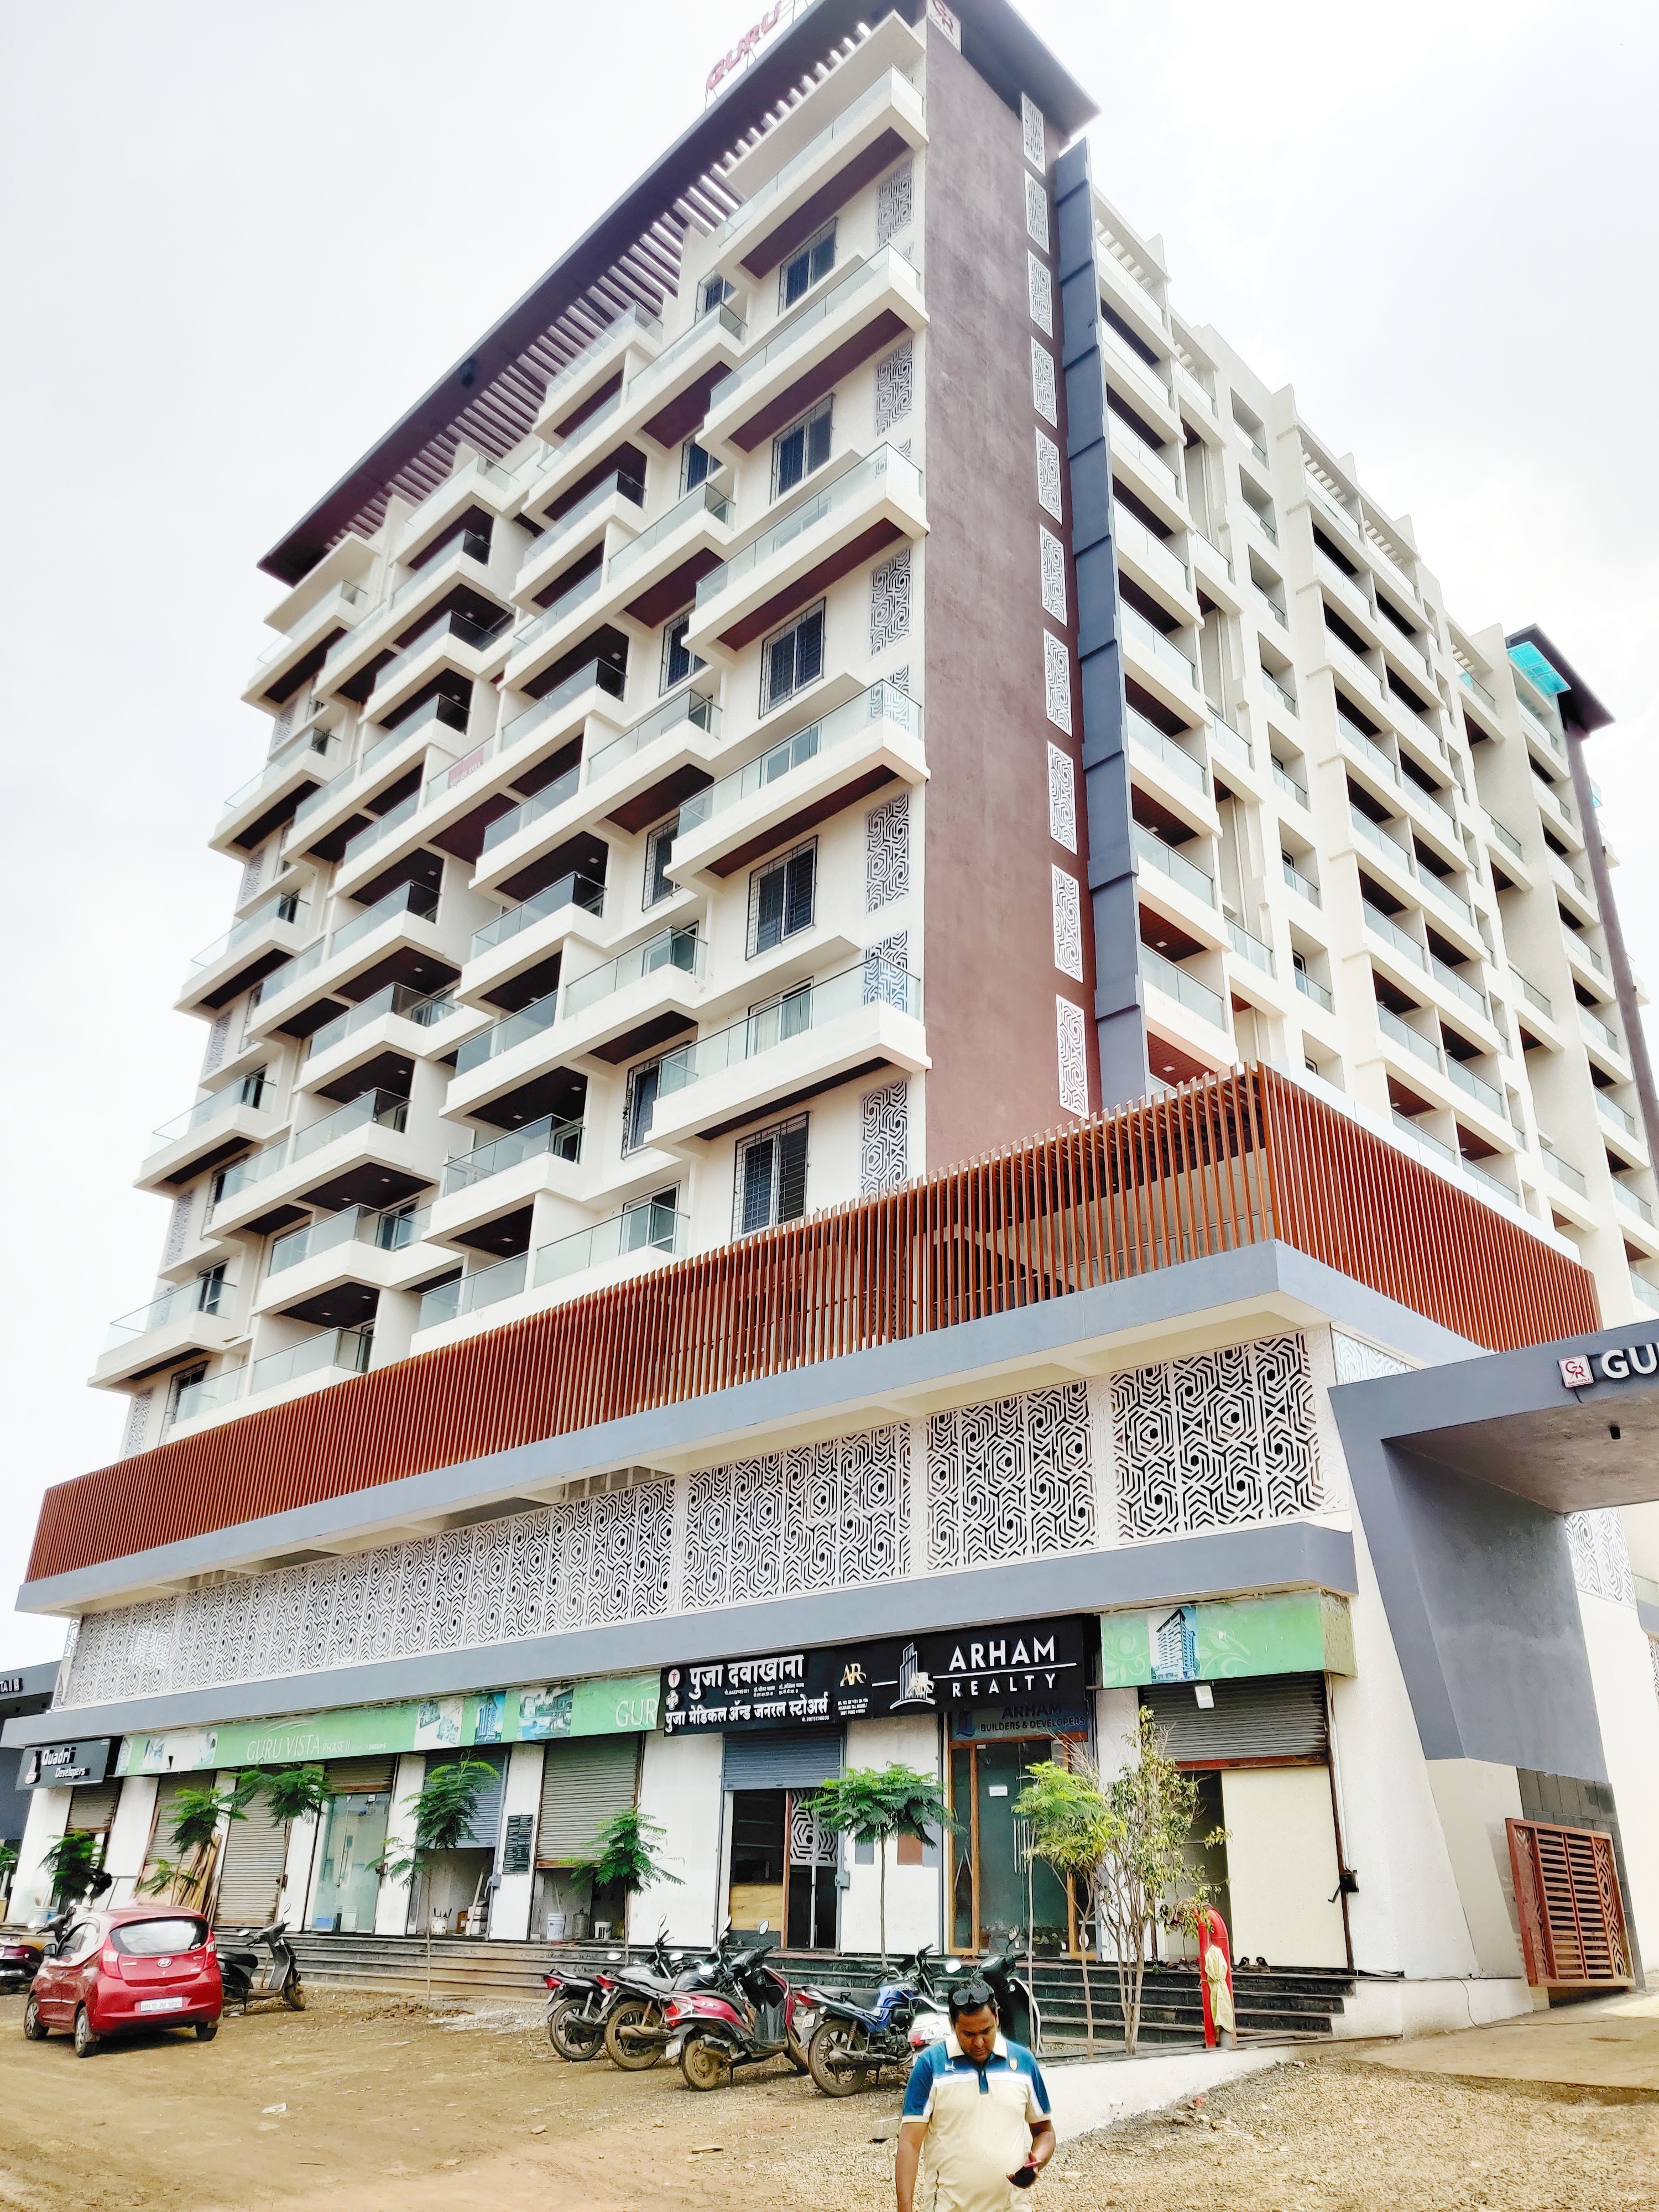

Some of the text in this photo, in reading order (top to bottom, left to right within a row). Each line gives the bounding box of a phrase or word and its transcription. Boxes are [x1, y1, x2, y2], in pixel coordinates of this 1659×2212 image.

[706, 0, 781, 90] GURU
[1601, 1342, 1659, 1379] GU
[948, 1635, 1055, 1671] ARHAM
[688, 1654, 805, 1700] पुजा दवाखाना
[952, 1673, 1056, 1698] REALTY
[615, 1698, 658, 1728] GUR
[665, 1712, 686, 1733] पुजा
[688, 1704, 728, 1725] मेडिकल
[753, 1702, 787, 1719] जनरल
[789, 1691, 829, 1717] स्टोअर्स
[980, 1720, 1020, 1732] BUILDERS
[1029, 1716, 1086, 1729] DEVELOPERS
[1001, 1701, 1062, 1719] ARHAM
[42, 1746, 72, 1766] Quadri
[246, 1738, 283, 1761] GURU
[286, 1734, 320, 1757] VISTA
[322, 1741, 345, 1752] PHASE
[54, 1766, 86, 1779] Developers
